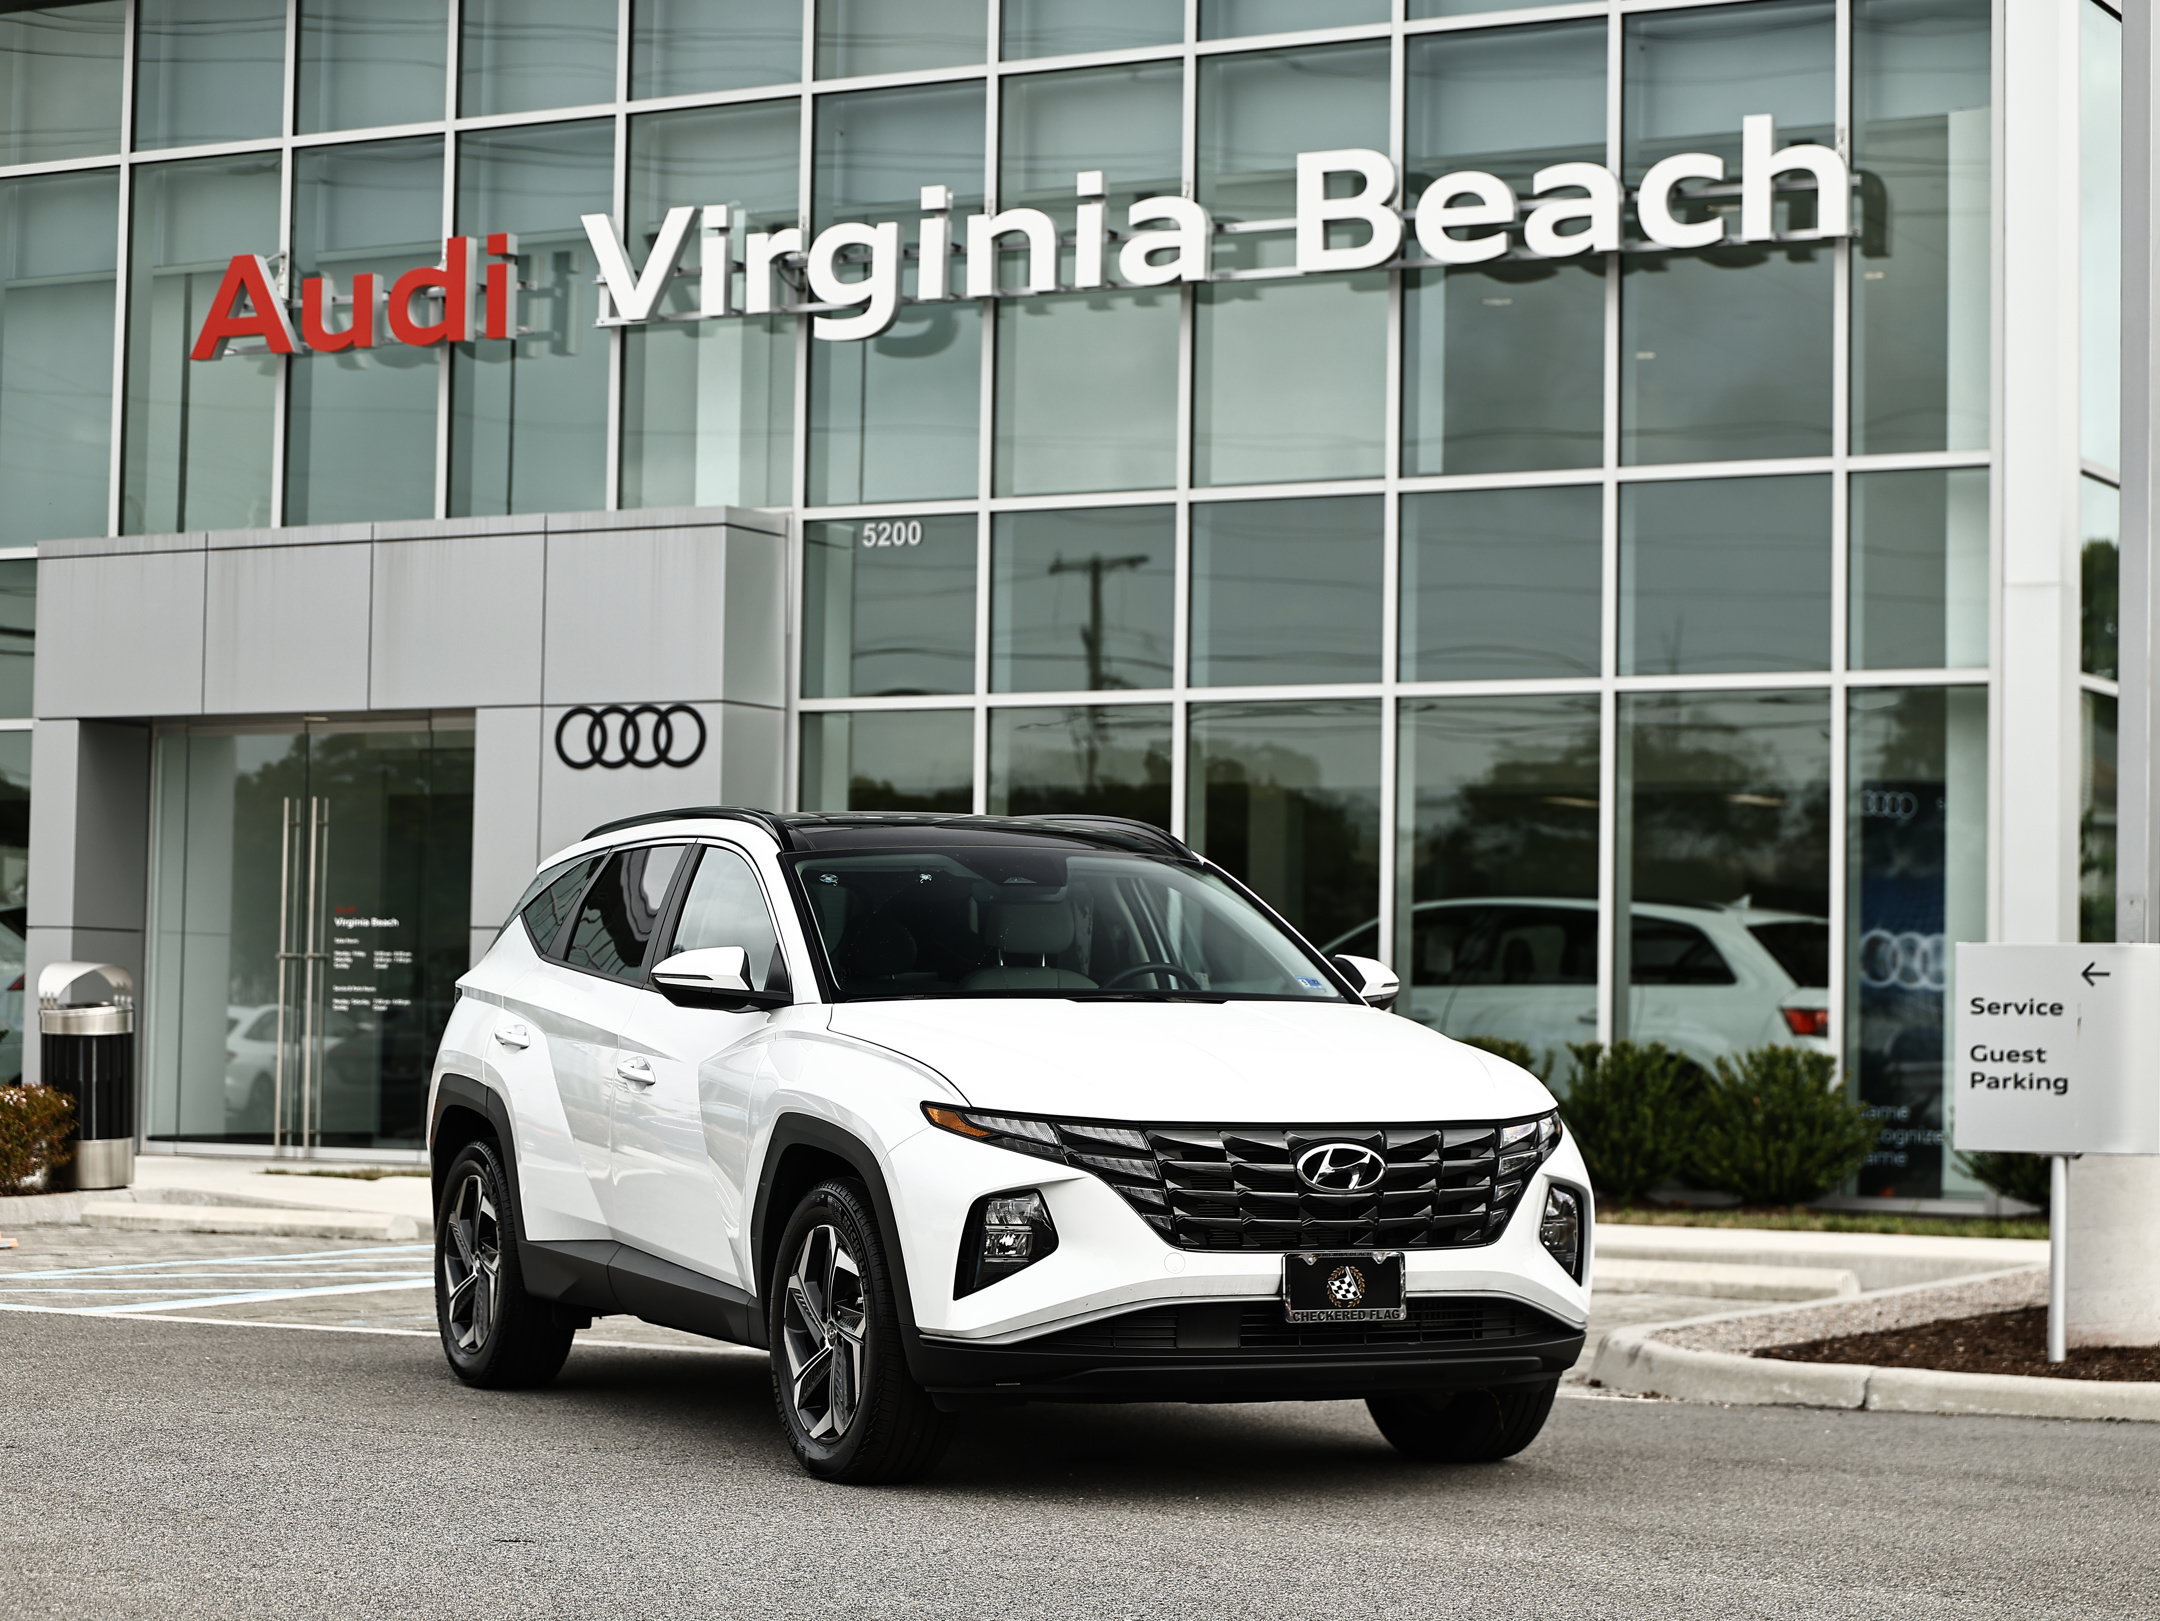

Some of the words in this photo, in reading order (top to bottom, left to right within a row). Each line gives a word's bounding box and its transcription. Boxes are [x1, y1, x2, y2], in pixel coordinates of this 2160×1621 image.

[190, 233, 517, 360] Audi
[580, 170, 1211, 342] Virginia
[1296, 113, 1851, 275] Beach
[862, 520, 922, 547] 5200
[1970, 997, 2064, 1016] Service
[1970, 1044, 2047, 1063] Guest
[1970, 1072, 2069, 1095] Parking
[1862, 1106, 1911, 1121] ame
[1292, 1310, 1366, 1321] CHECKERED
[1370, 1309, 1400, 1320] FLAG
